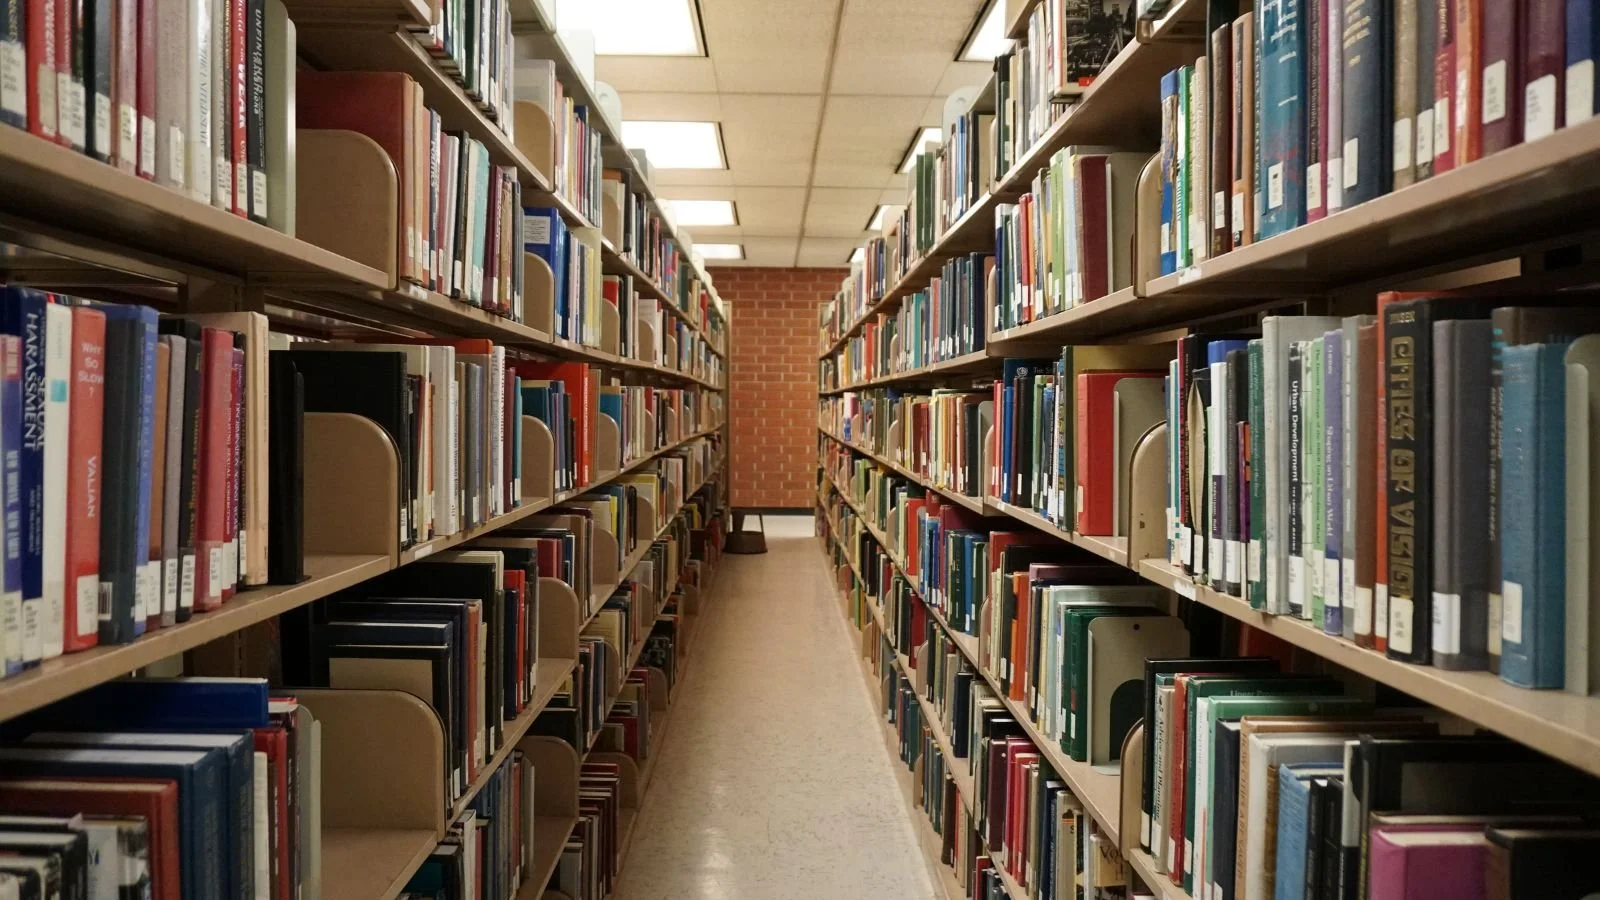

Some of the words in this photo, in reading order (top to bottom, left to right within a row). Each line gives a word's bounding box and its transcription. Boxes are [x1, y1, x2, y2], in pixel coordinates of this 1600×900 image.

[238, 63, 247, 129] WEAK
[24, 312, 39, 451] HARASSMENT
[35, 376, 46, 450] SEXUAL
[1292, 380, 1300, 412] Urban
[1390, 336, 1416, 442] CITIES
[1290, 414, 1300, 483] Development
[1325, 425, 1334, 464] Shaping
[1390, 449, 1416, 496] OF
[86, 455, 97, 518] VALIAN
[1156, 774, 1164, 819] Planning
